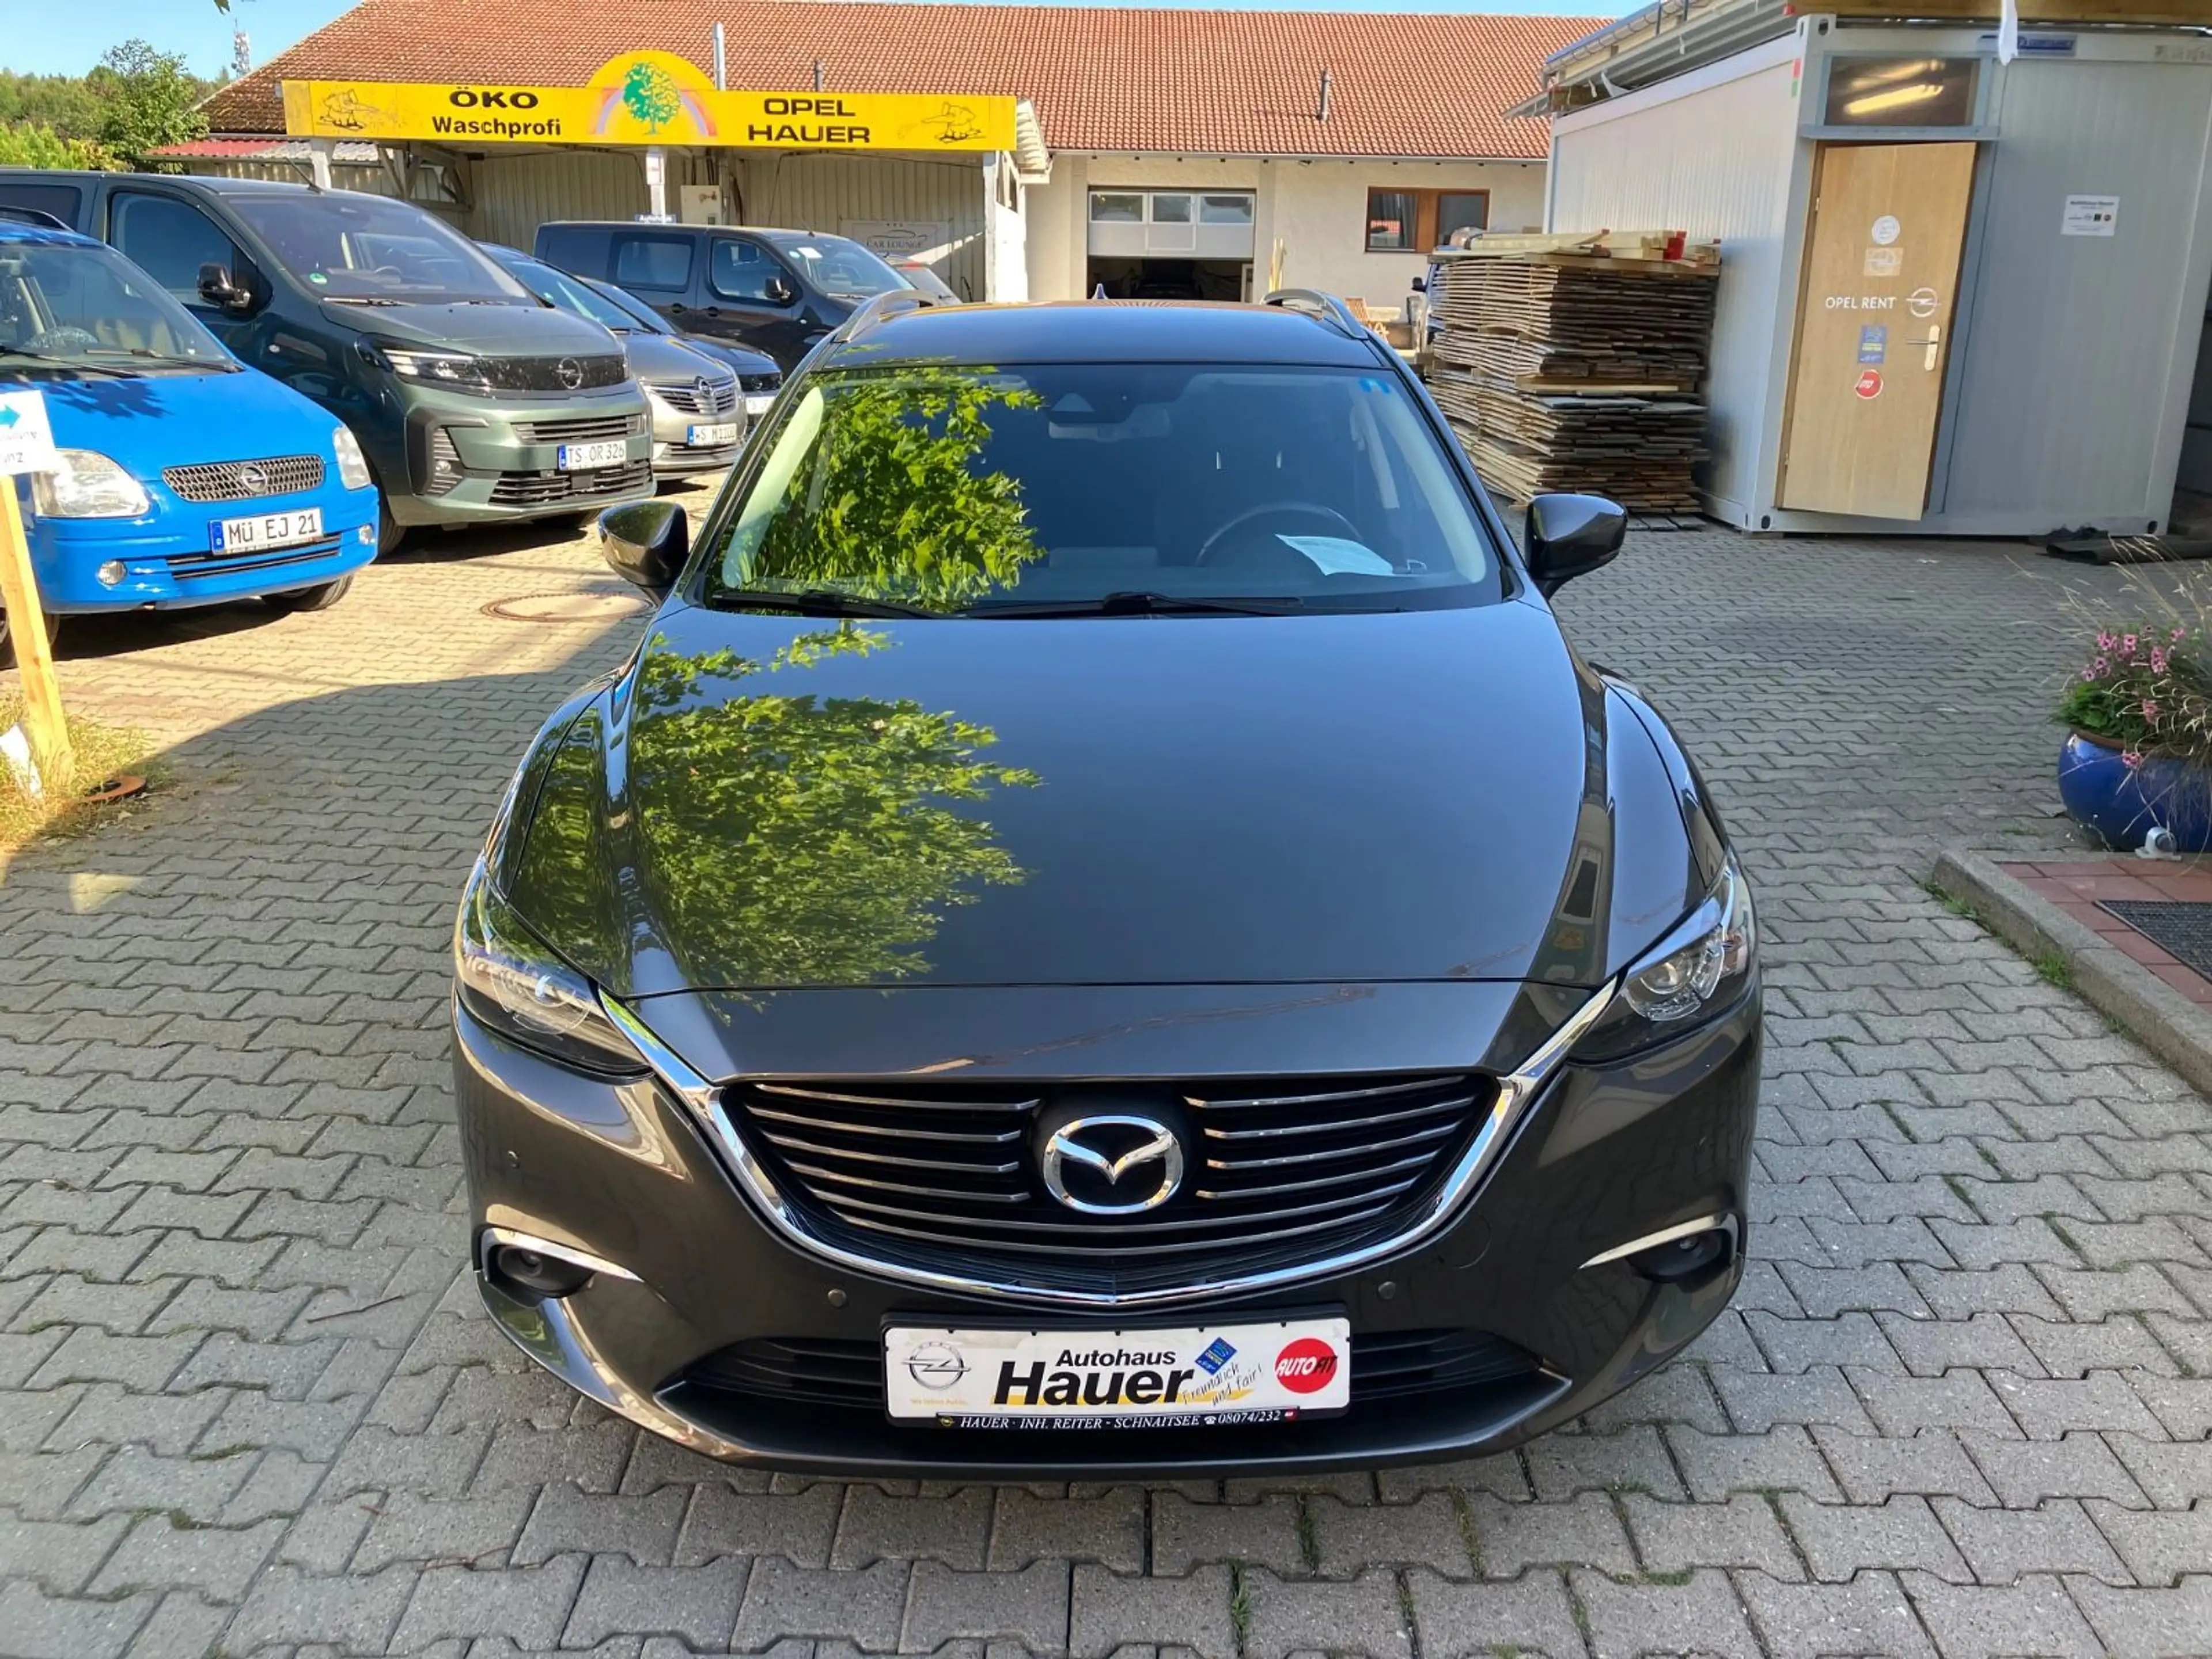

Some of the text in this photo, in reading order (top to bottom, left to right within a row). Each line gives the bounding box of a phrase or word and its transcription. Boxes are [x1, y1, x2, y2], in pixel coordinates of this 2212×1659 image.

[449, 86, 539, 109] ÖKO
[764, 98, 856, 117] OPEL
[432, 116, 561, 139] Waschprofi
[748, 124, 870, 143] HAUER
[1825, 297, 1897, 309] OPEL RENT
[266, 517, 289, 539] EJ
[298, 514, 317, 535] 21
[1056, 1349, 1176, 1367] Autohaus
[994, 1361, 1195, 1406] Hauer
[1183, 1361, 1239, 1404] Freundlich
[961, 1410, 1281, 1429] HAUER INH. REITER SCHNAITSEE 08074/232
